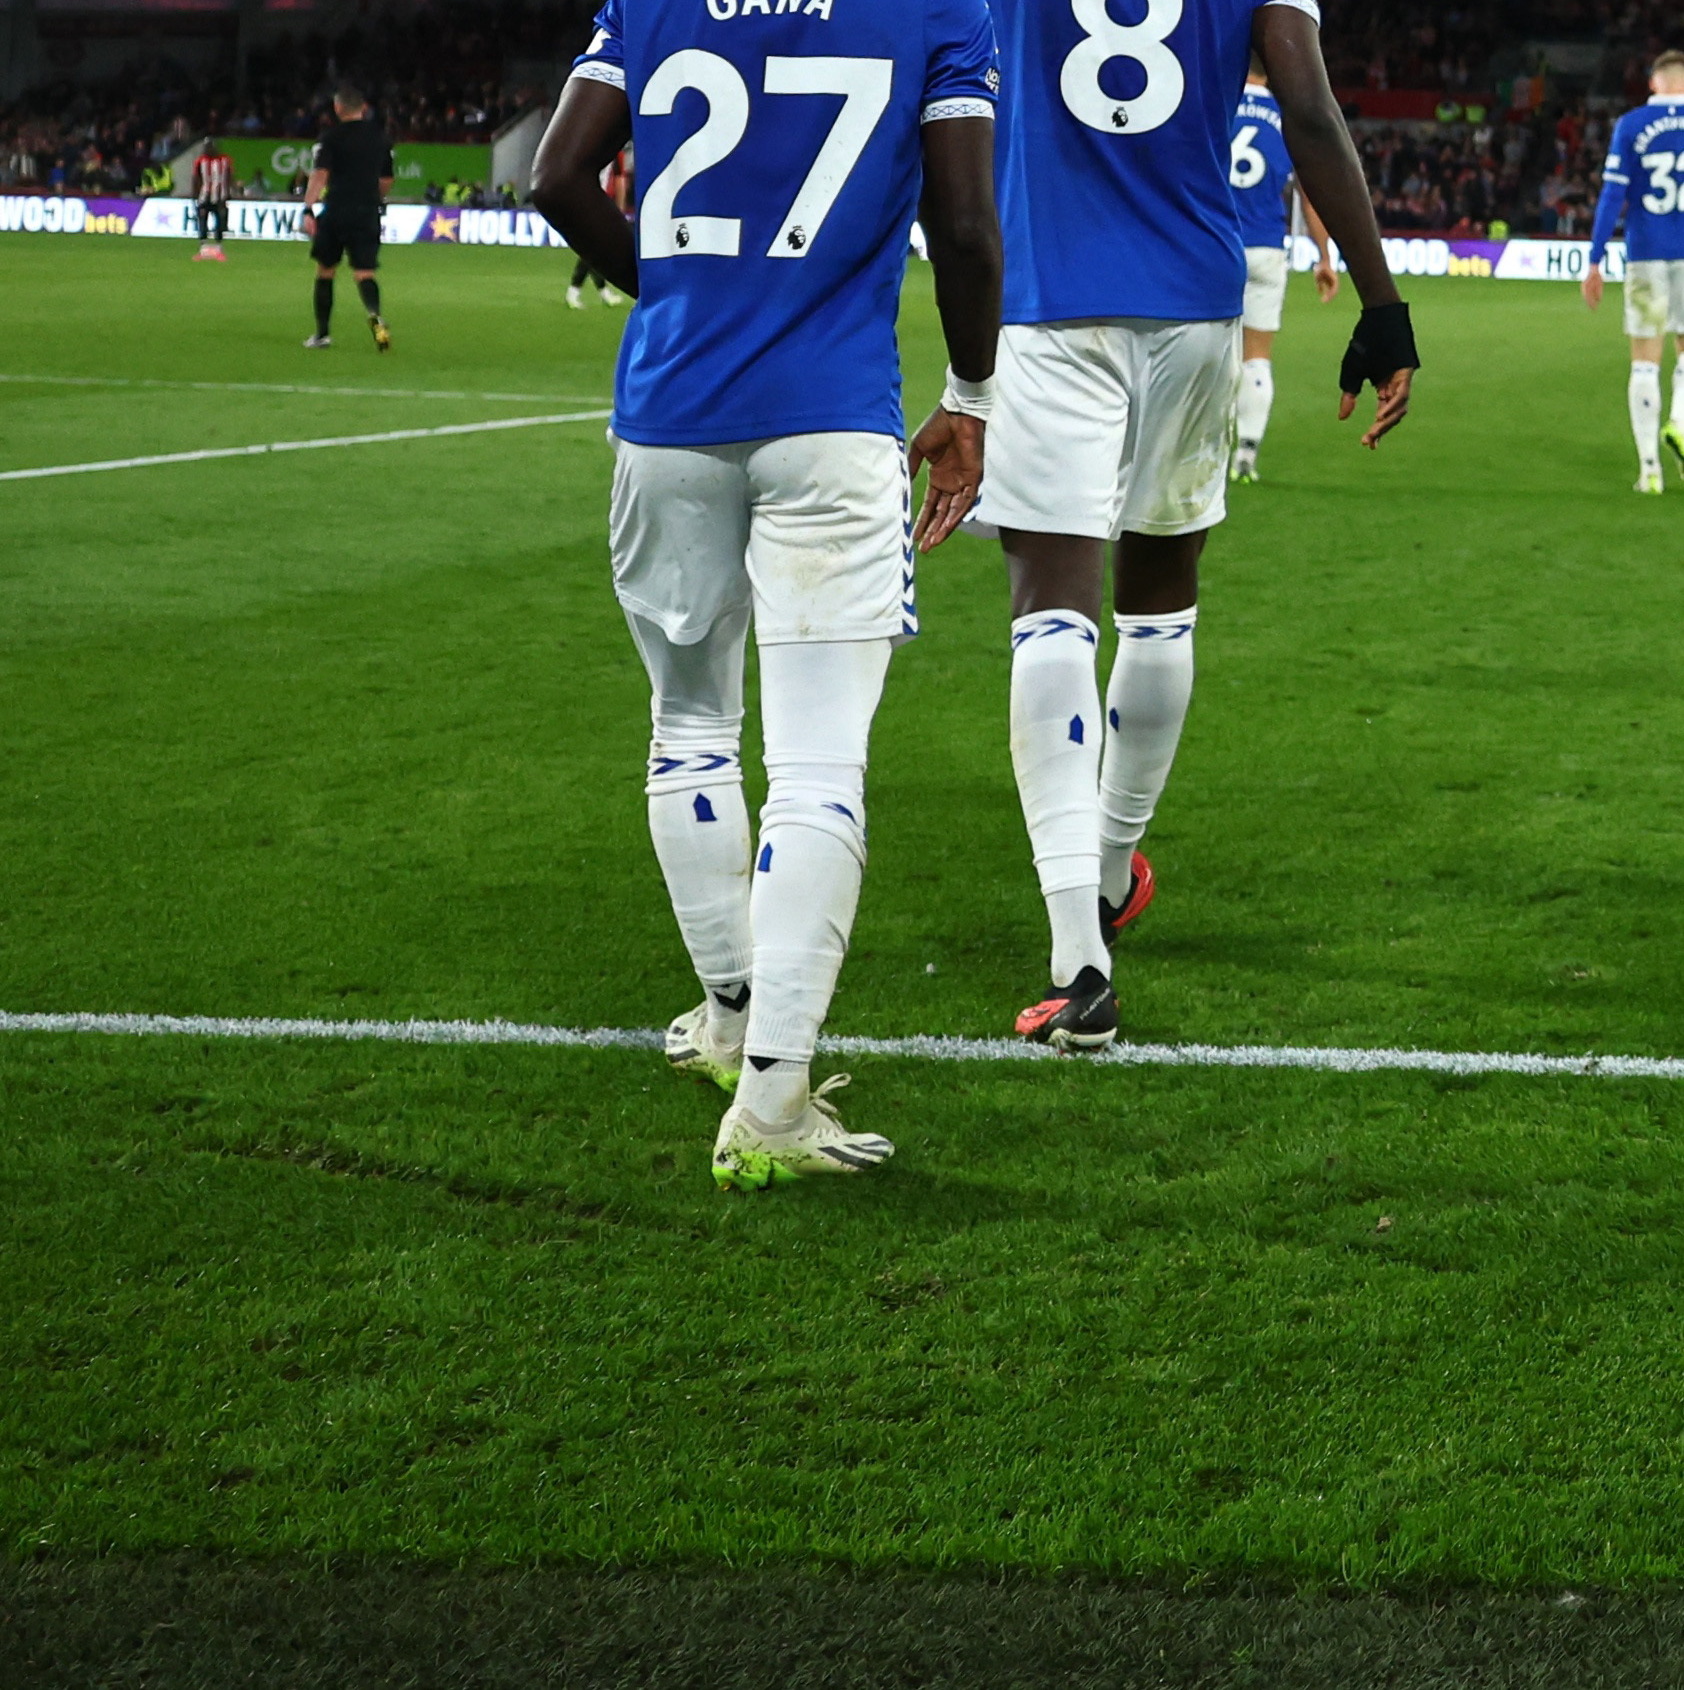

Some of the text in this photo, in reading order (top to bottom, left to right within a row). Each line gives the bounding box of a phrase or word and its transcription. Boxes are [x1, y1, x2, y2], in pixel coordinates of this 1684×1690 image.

[638, 48, 894, 260] 27
[1229, 125, 1266, 189] 6
[84, 212, 128, 235] bets
[1448, 253, 1492, 277] bets
